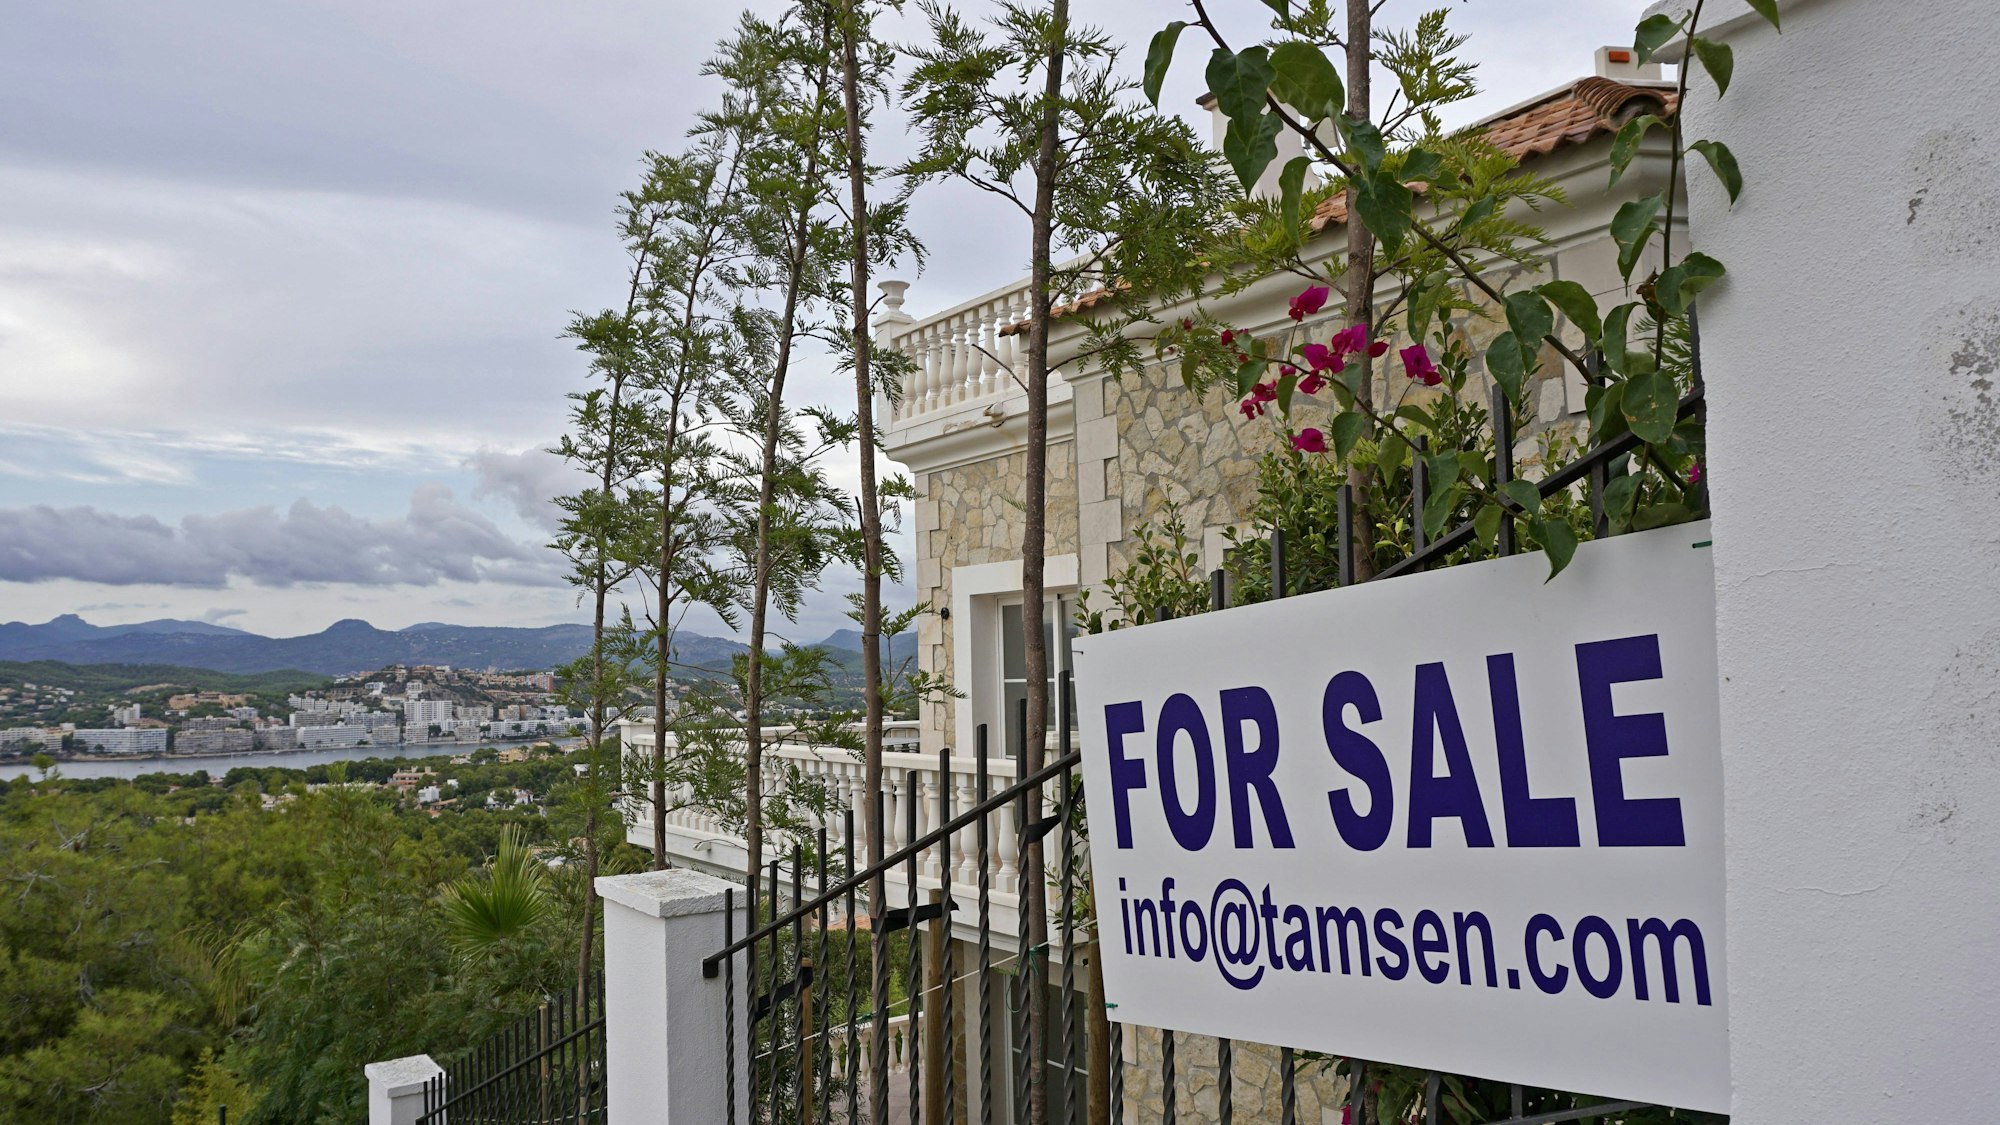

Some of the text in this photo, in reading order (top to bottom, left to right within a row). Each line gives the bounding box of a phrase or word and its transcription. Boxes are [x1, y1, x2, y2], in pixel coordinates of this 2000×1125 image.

[1104, 633, 1686, 852] FOR SALE
[1118, 876, 1713, 1007] info@tamsen.com
